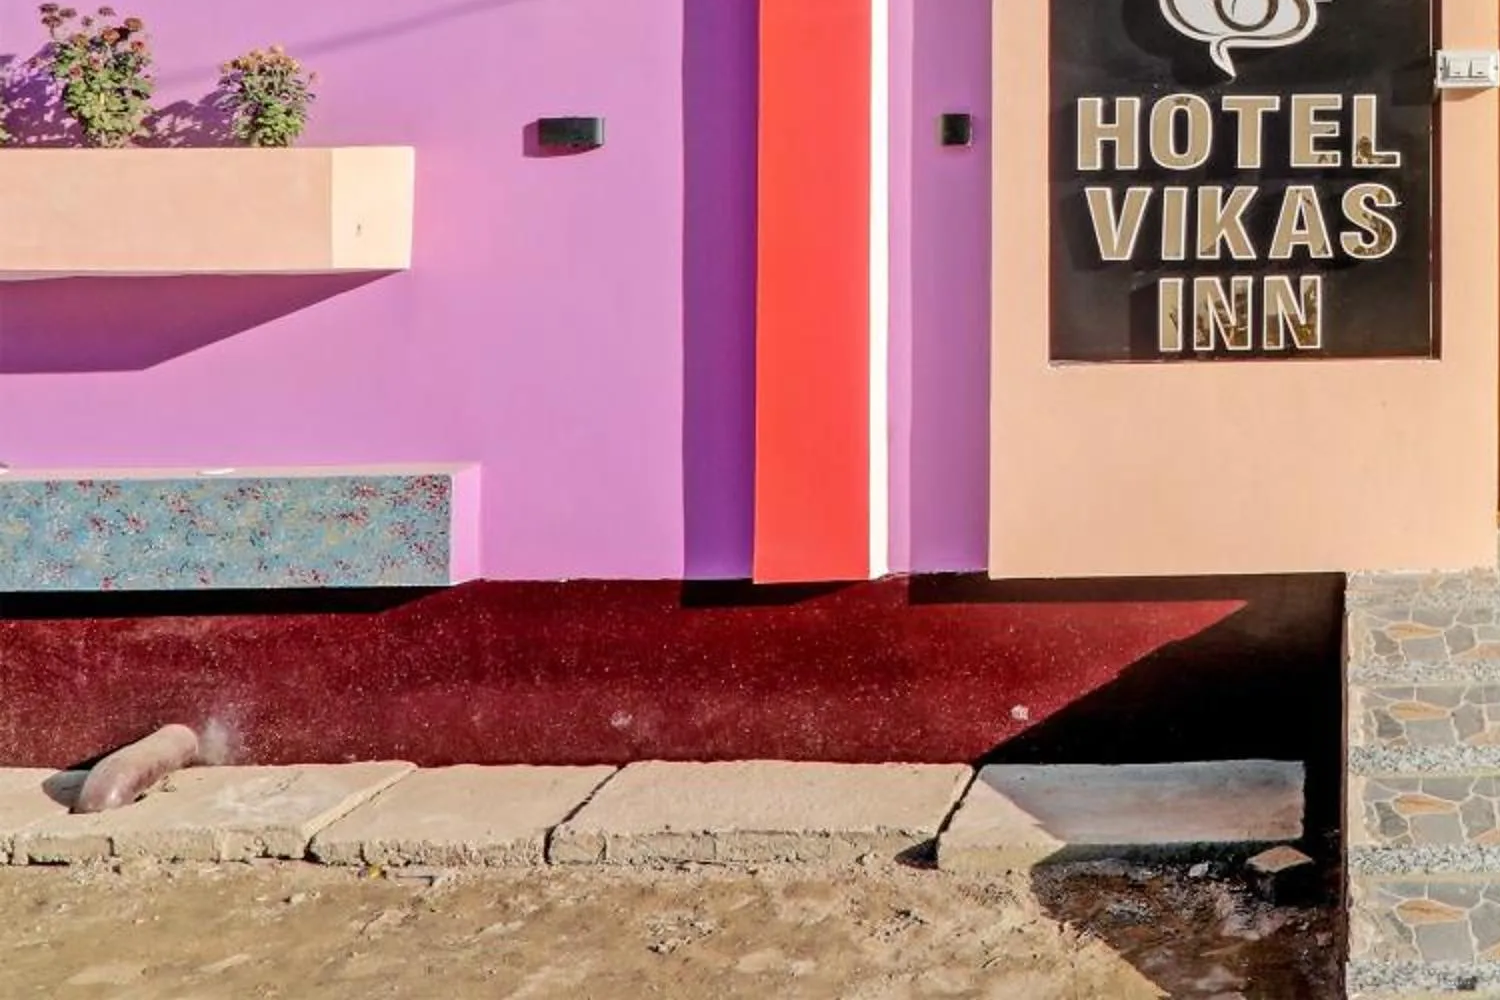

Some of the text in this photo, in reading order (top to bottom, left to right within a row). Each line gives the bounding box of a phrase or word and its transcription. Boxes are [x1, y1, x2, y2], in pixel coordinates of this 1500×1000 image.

[1076, 94, 1402, 171] HOTEL
[1085, 183, 1400, 262] VIKAS
[1158, 275, 1323, 353] INN
